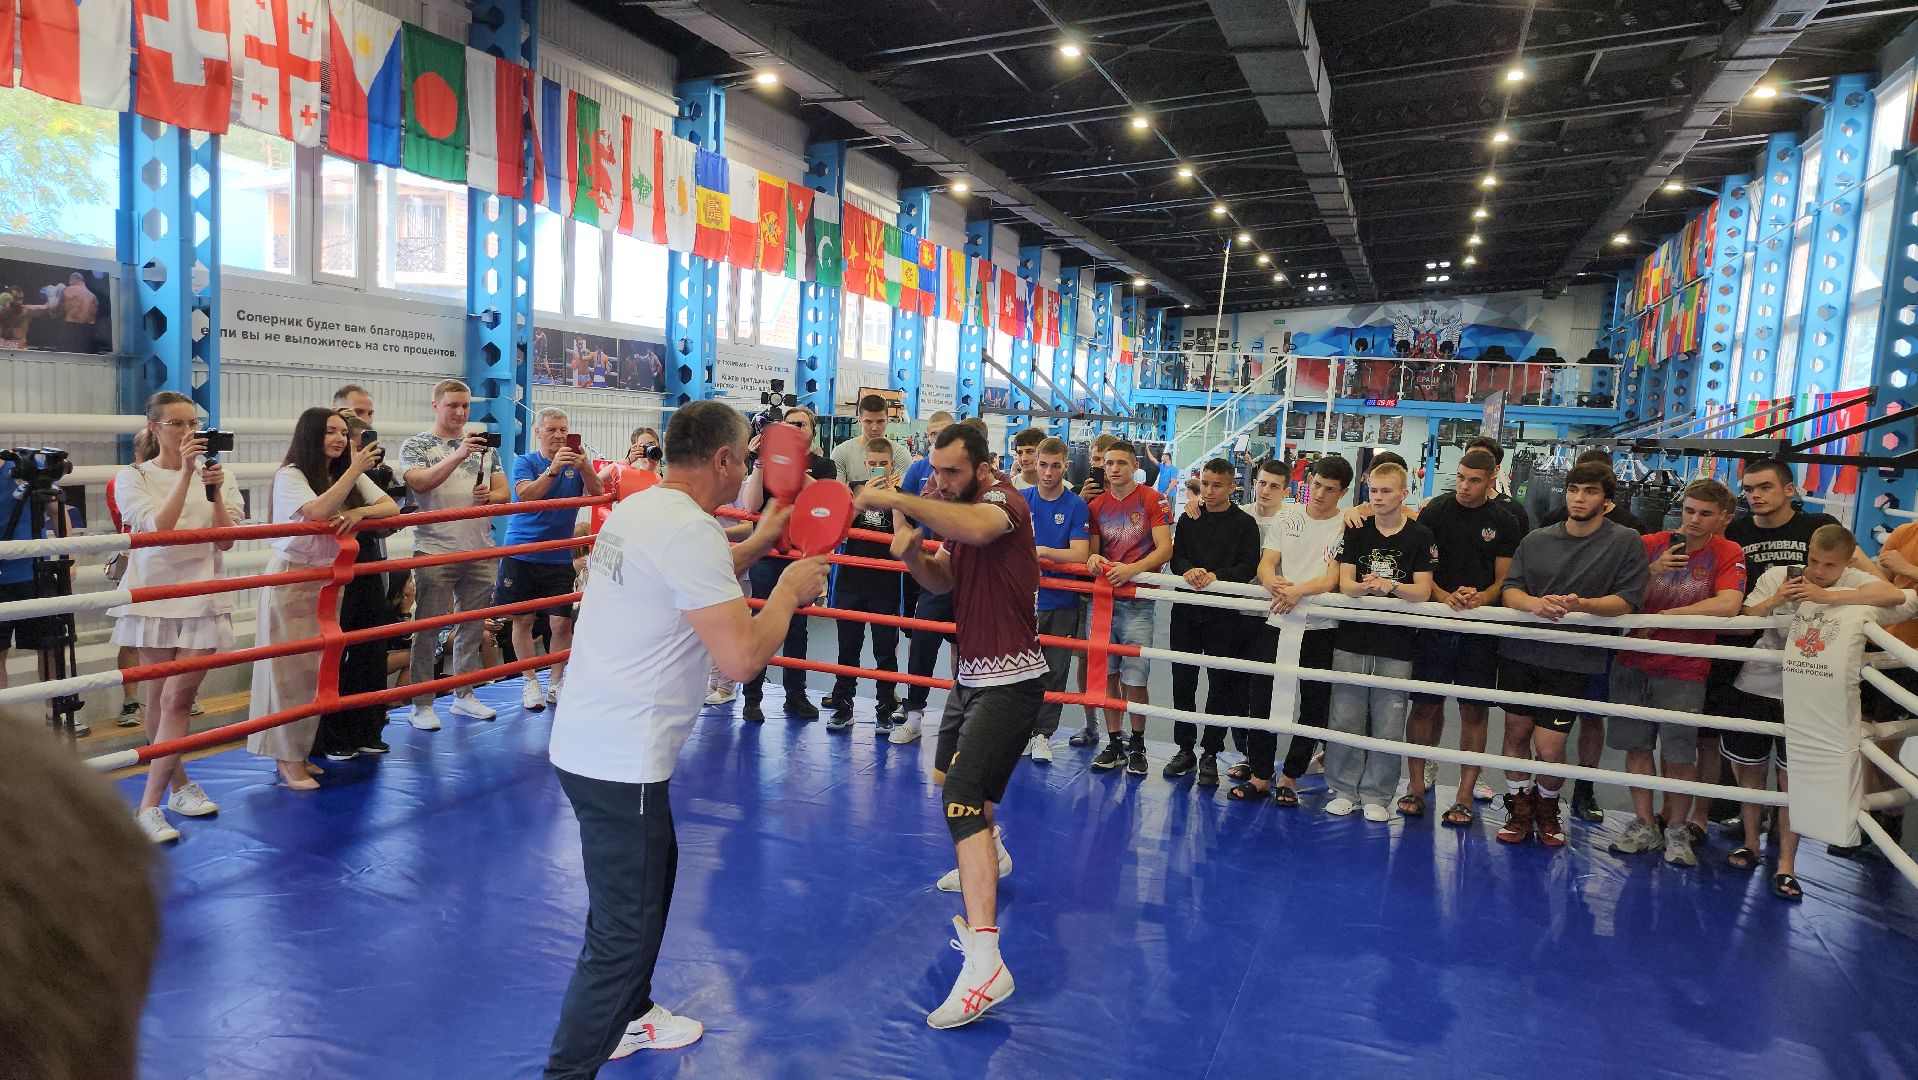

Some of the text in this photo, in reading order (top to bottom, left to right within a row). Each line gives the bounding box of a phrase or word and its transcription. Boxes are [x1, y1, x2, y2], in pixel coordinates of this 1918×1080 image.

[236, 309, 435, 342] Соперник будет вам благодарен,
[241, 330, 260, 341] вы
[264, 332, 281, 342] не
[284, 334, 362, 350] выложитесь
[365, 341, 379, 351] на
[382, 343, 400, 353] сто
[403, 345, 457, 358] процентов.
[1742, 540, 1807, 555] ПОРТИВНАЯ
[1748, 551, 1804, 563] ДЕРАЦИЯ
